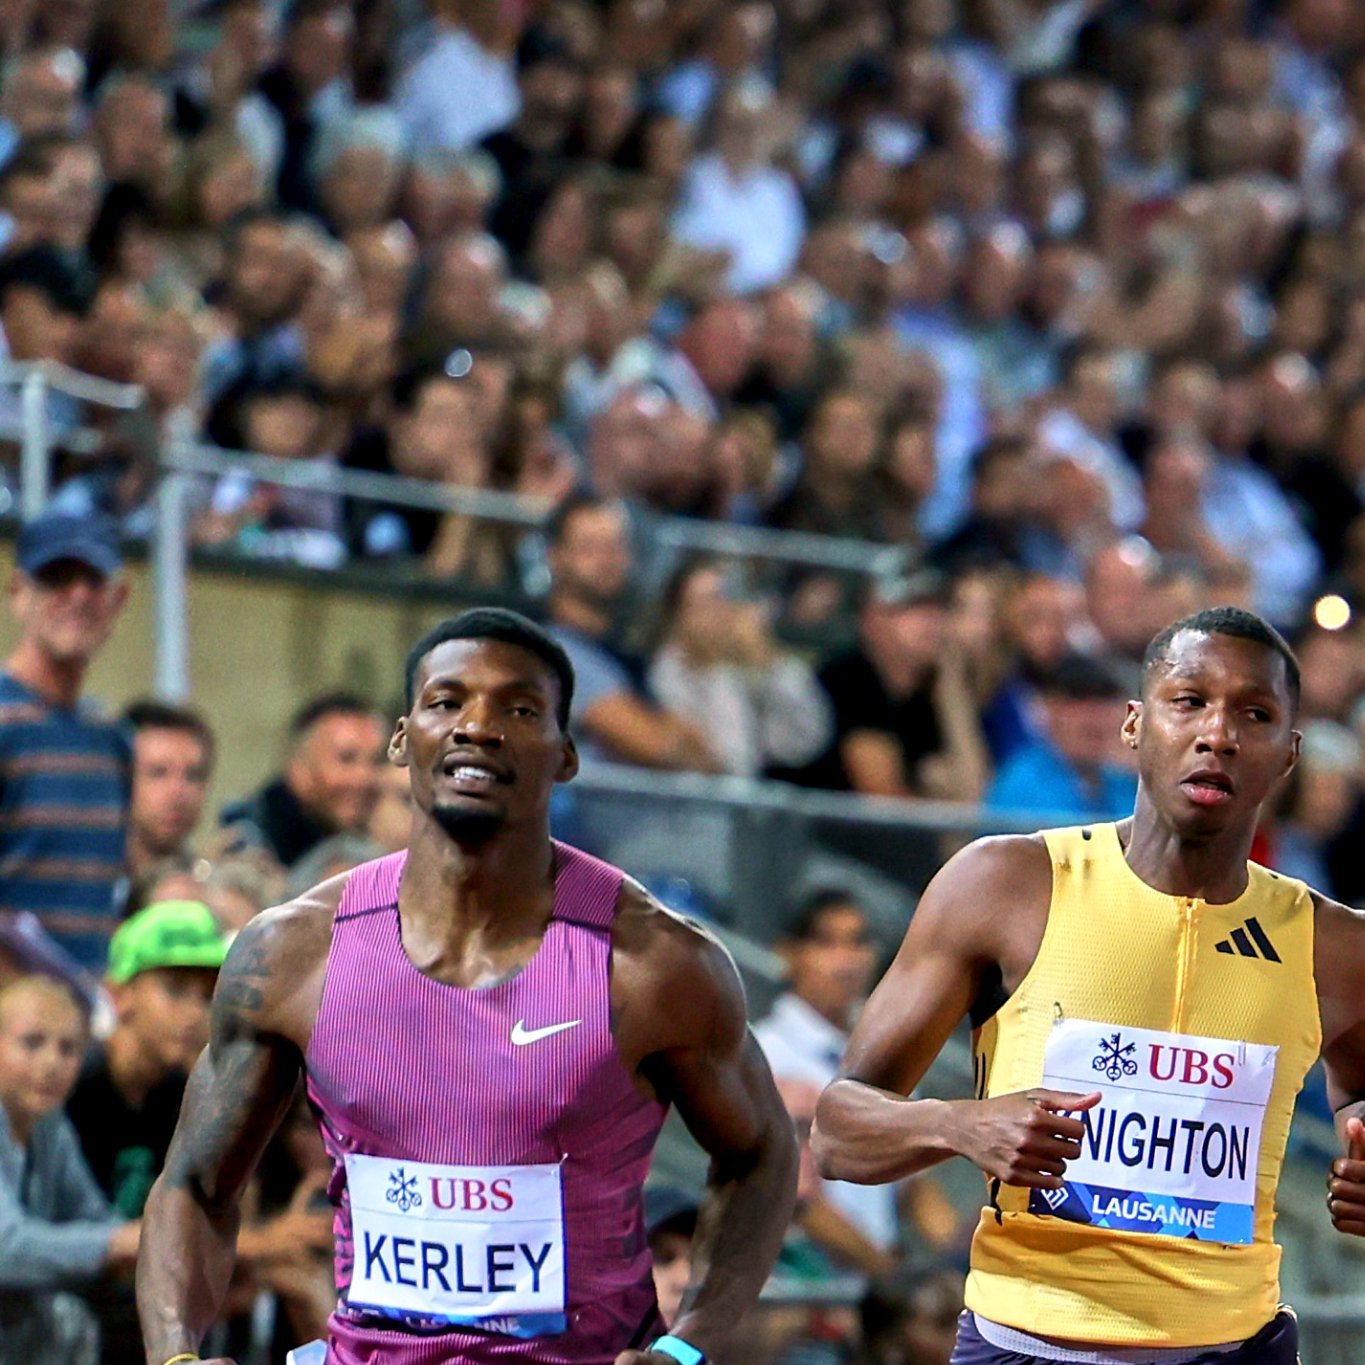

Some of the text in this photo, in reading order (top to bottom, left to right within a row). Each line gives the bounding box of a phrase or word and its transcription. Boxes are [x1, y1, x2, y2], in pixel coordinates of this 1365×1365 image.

[1148, 1044, 1236, 1089] UBS
[1055, 1107, 1250, 1181] NIGHTON
[428, 1177, 515, 1212] UBS
[1092, 1194, 1216, 1229] LAUSANNE
[363, 1230, 553, 1294] KERLEY
